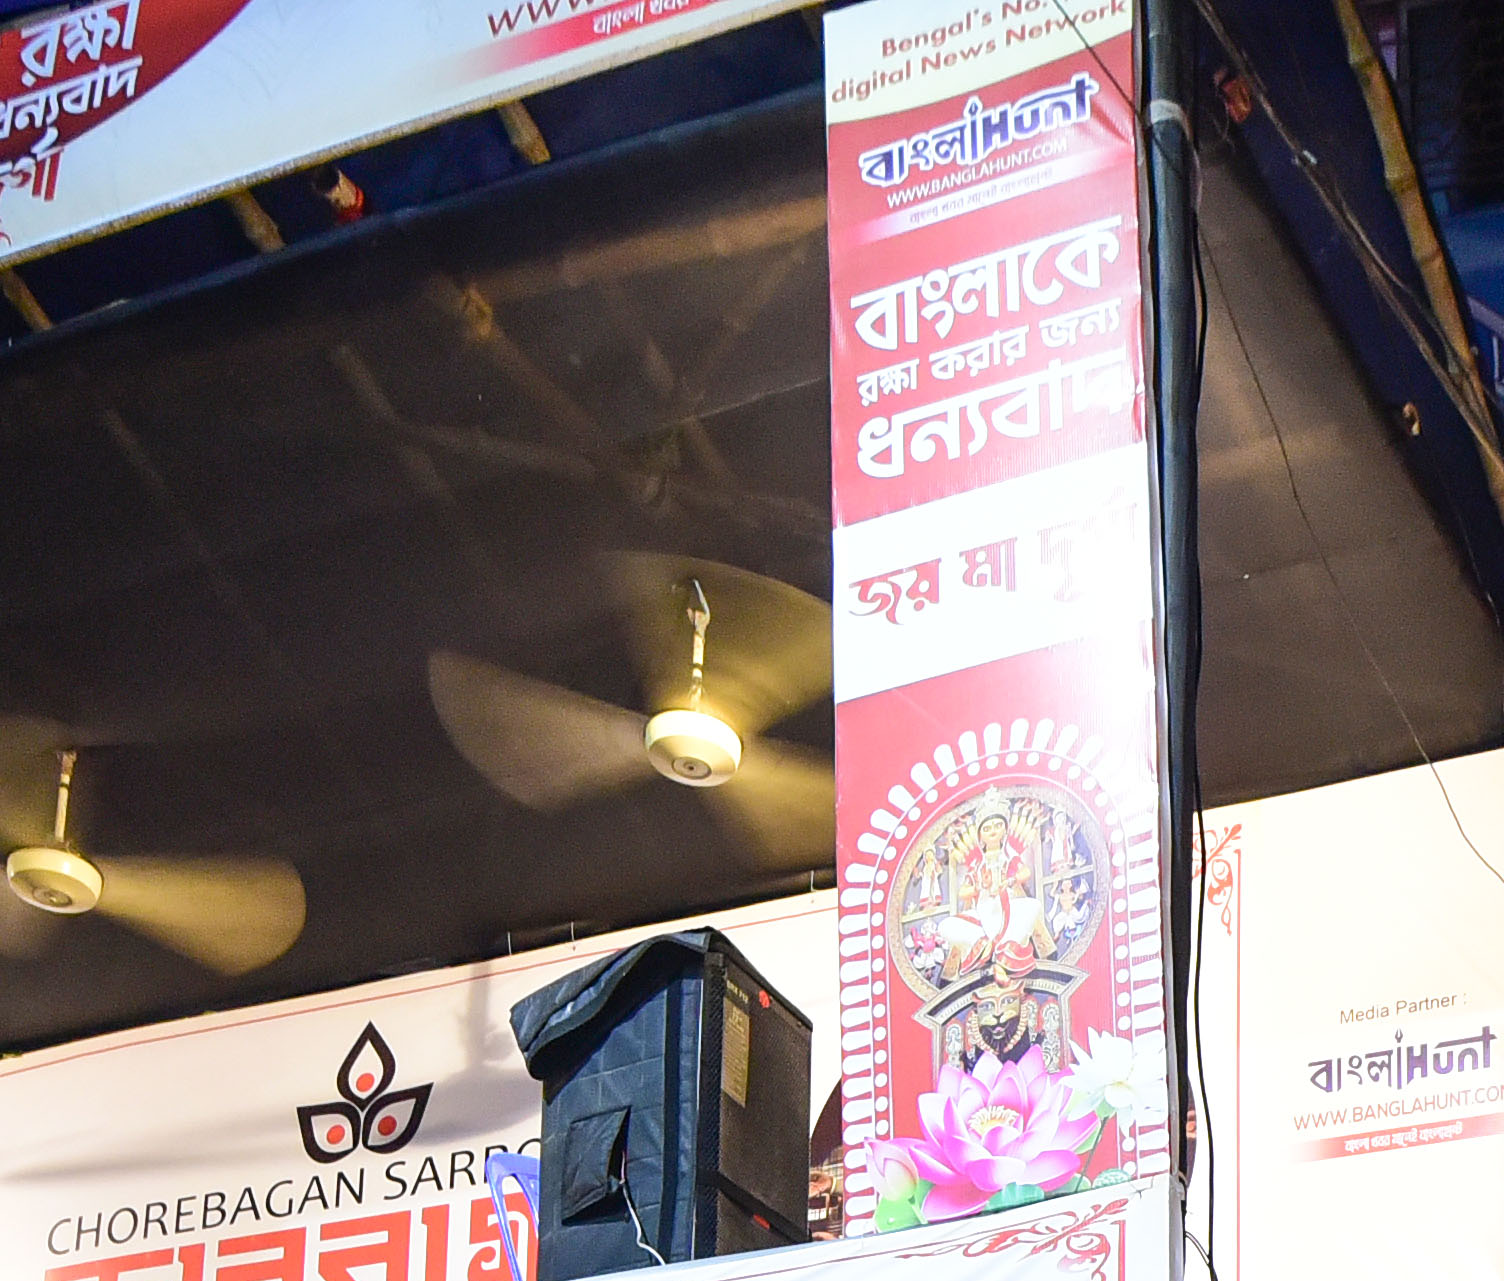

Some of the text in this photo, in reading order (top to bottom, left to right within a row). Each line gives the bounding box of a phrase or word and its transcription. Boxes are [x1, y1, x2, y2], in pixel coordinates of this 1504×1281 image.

[20, 0, 141, 88] রক্ষা
[831, 1, 1126, 103] digital News Network
[881, 9, 992, 58] Bengal's
[887, 137, 1069, 208] WWW.BANGLAHUNT.COM
[850, 214, 1123, 350] বাংলাকে
[857, 297, 1122, 406] রক্ষা করার জন্য
[857, 346, 1128, 479] ধন্যবাদ
[958, 537, 1018, 593] মা
[1340, 992, 1458, 1025] Media Partner
[47, 1167, 367, 1256] CHOREBAGAN
